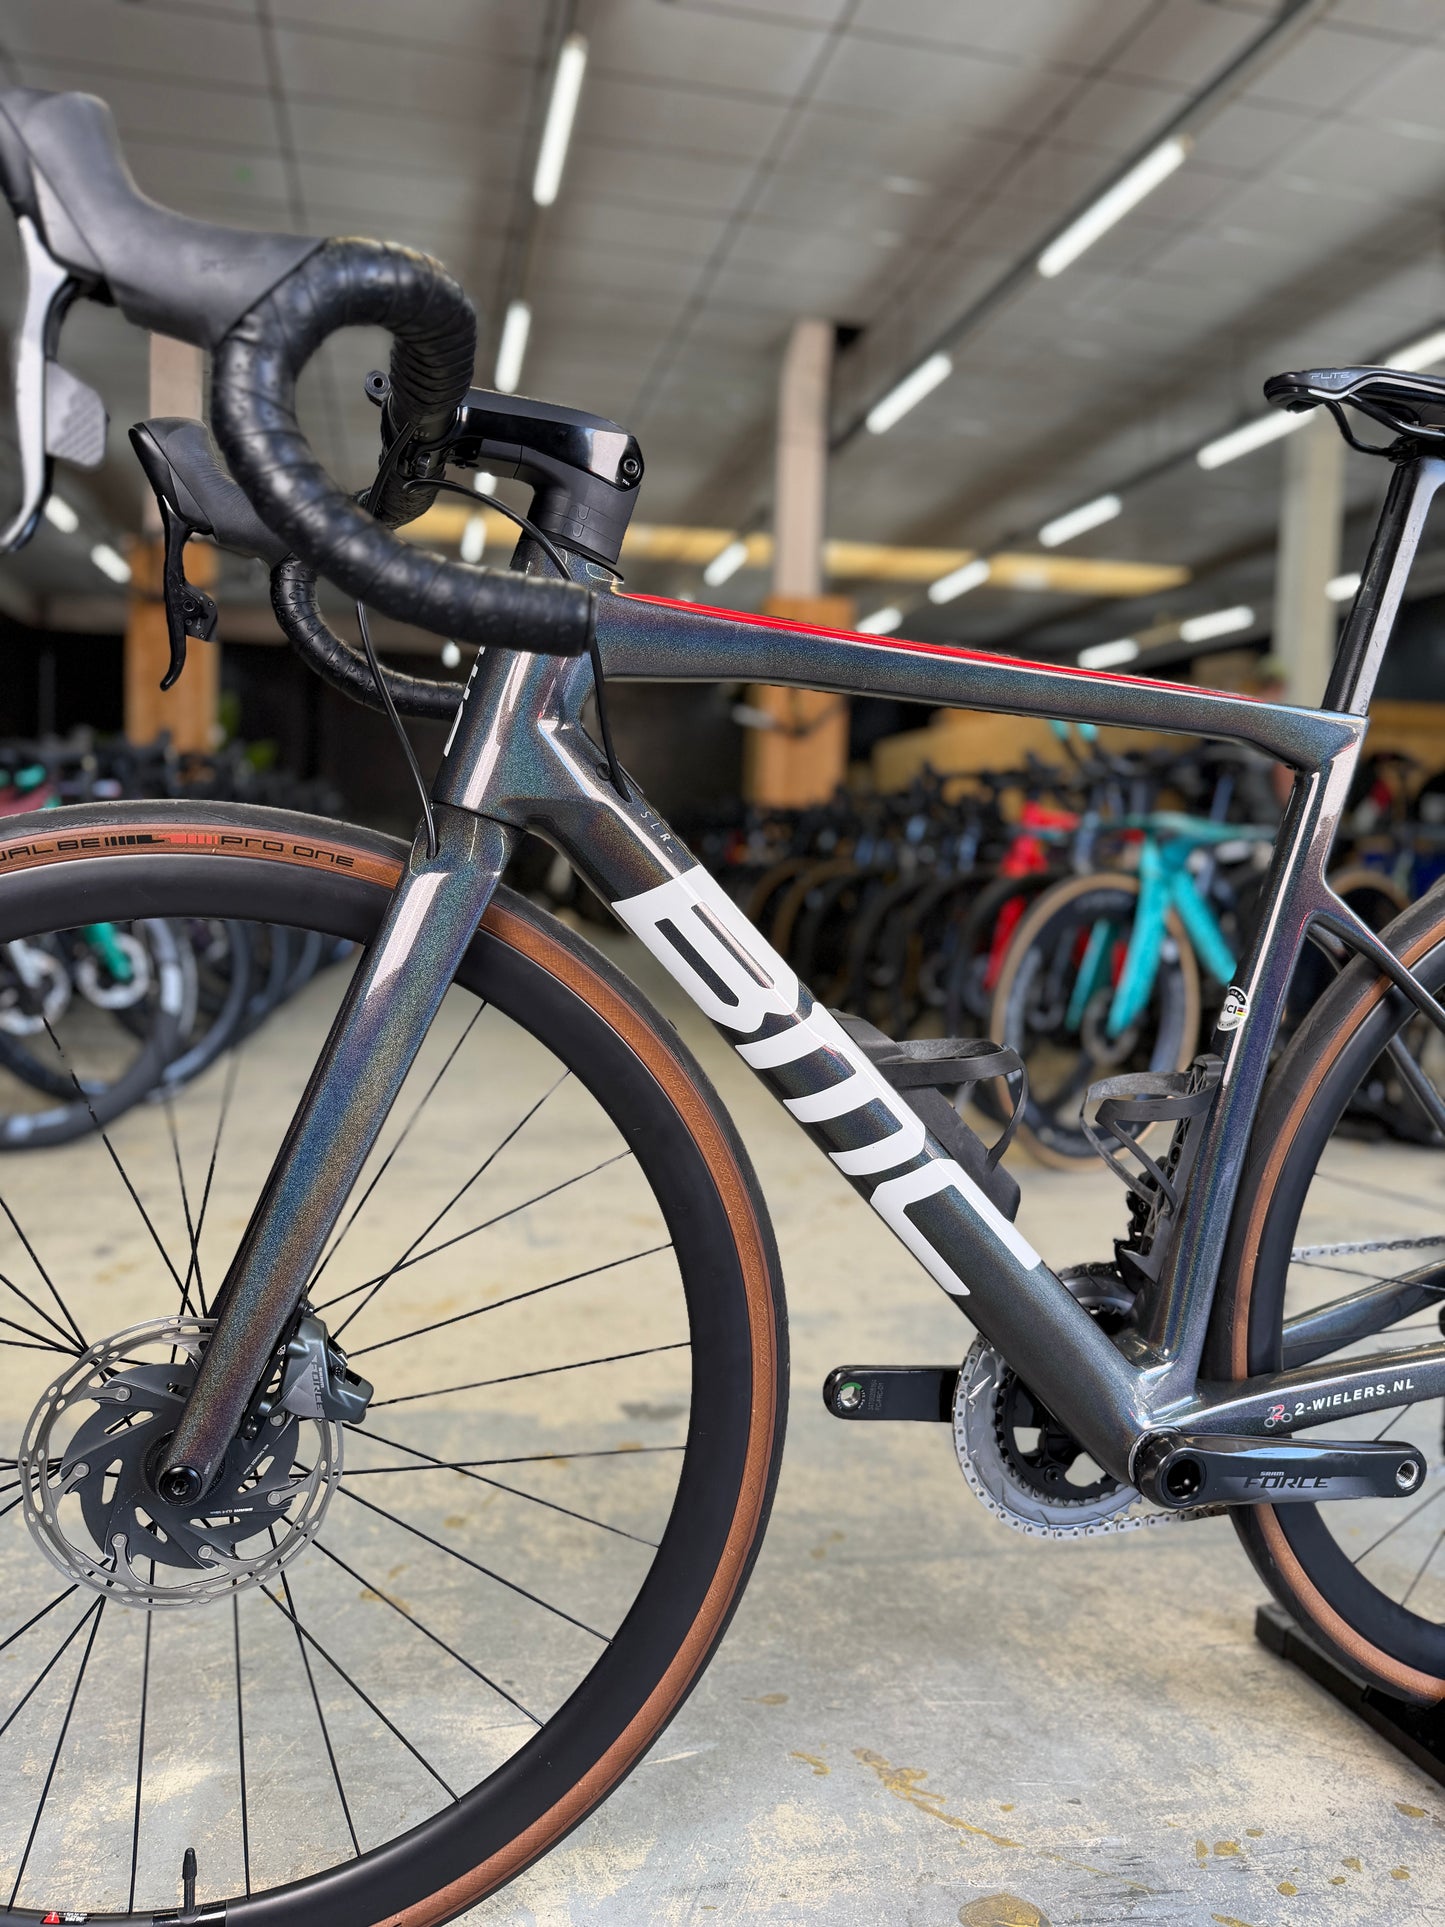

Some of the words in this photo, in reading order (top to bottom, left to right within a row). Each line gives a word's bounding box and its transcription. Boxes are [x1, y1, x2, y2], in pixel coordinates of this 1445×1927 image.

[311, 1361, 323, 1411] FORCE
[1294, 1378, 1415, 1416] 2-WIELERS.NL
[1242, 1476, 1332, 1489] FORCE
